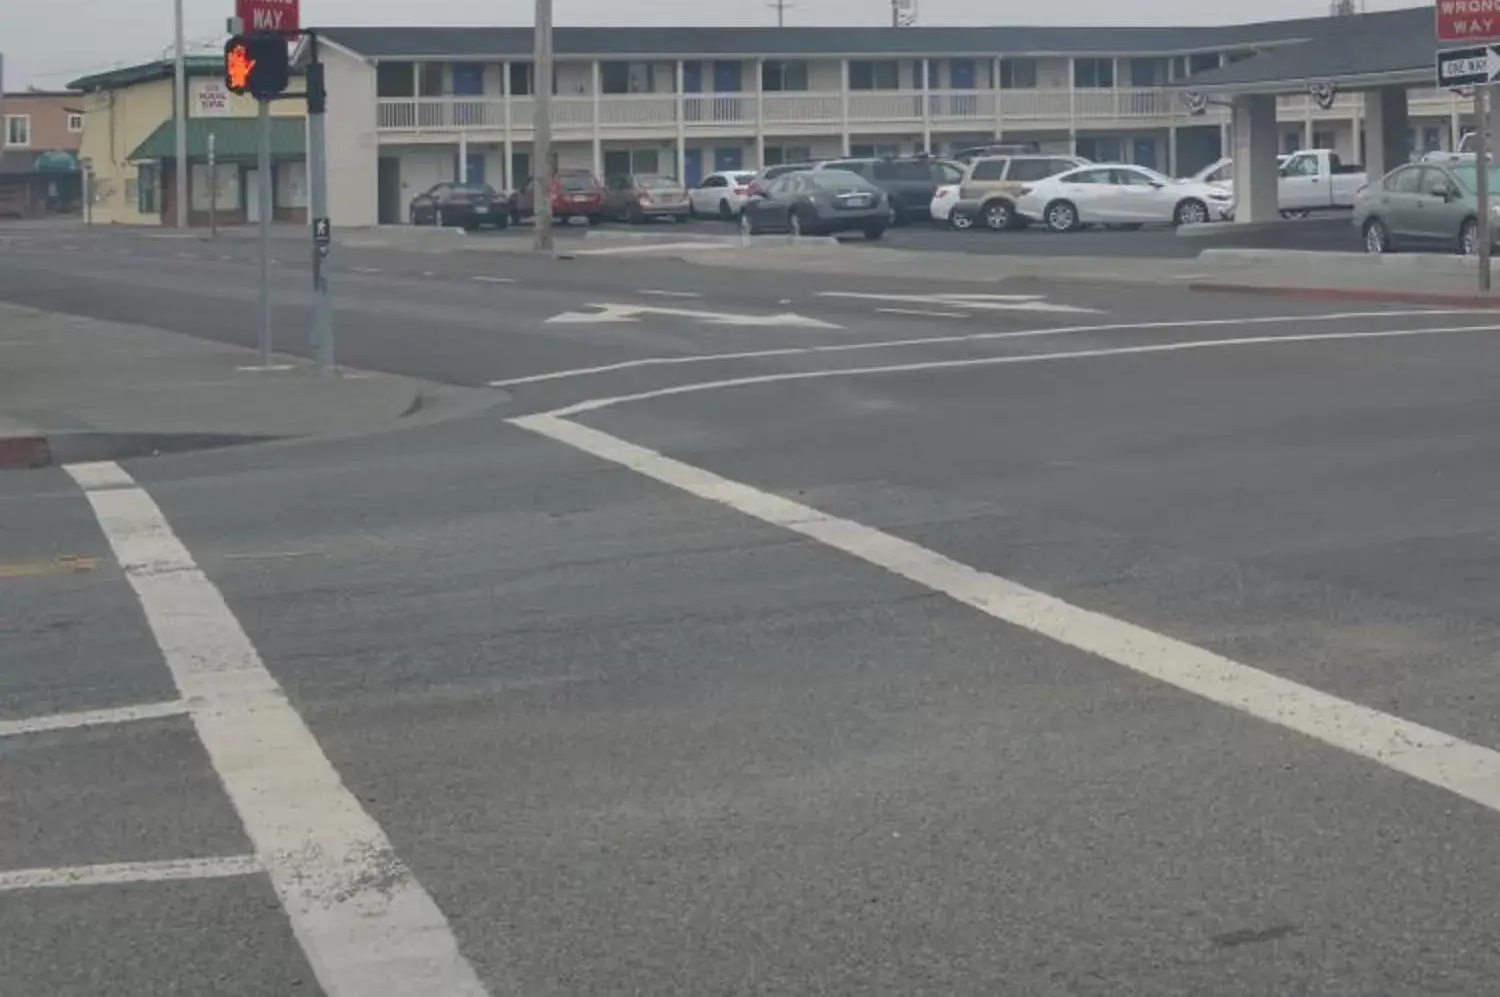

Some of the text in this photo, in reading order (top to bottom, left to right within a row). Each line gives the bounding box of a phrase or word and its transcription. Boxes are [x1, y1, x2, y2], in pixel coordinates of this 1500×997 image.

[252, 6, 283, 30] WAY
[1453, 18, 1494, 35] WAY
[1448, 59, 1465, 76] ONE
